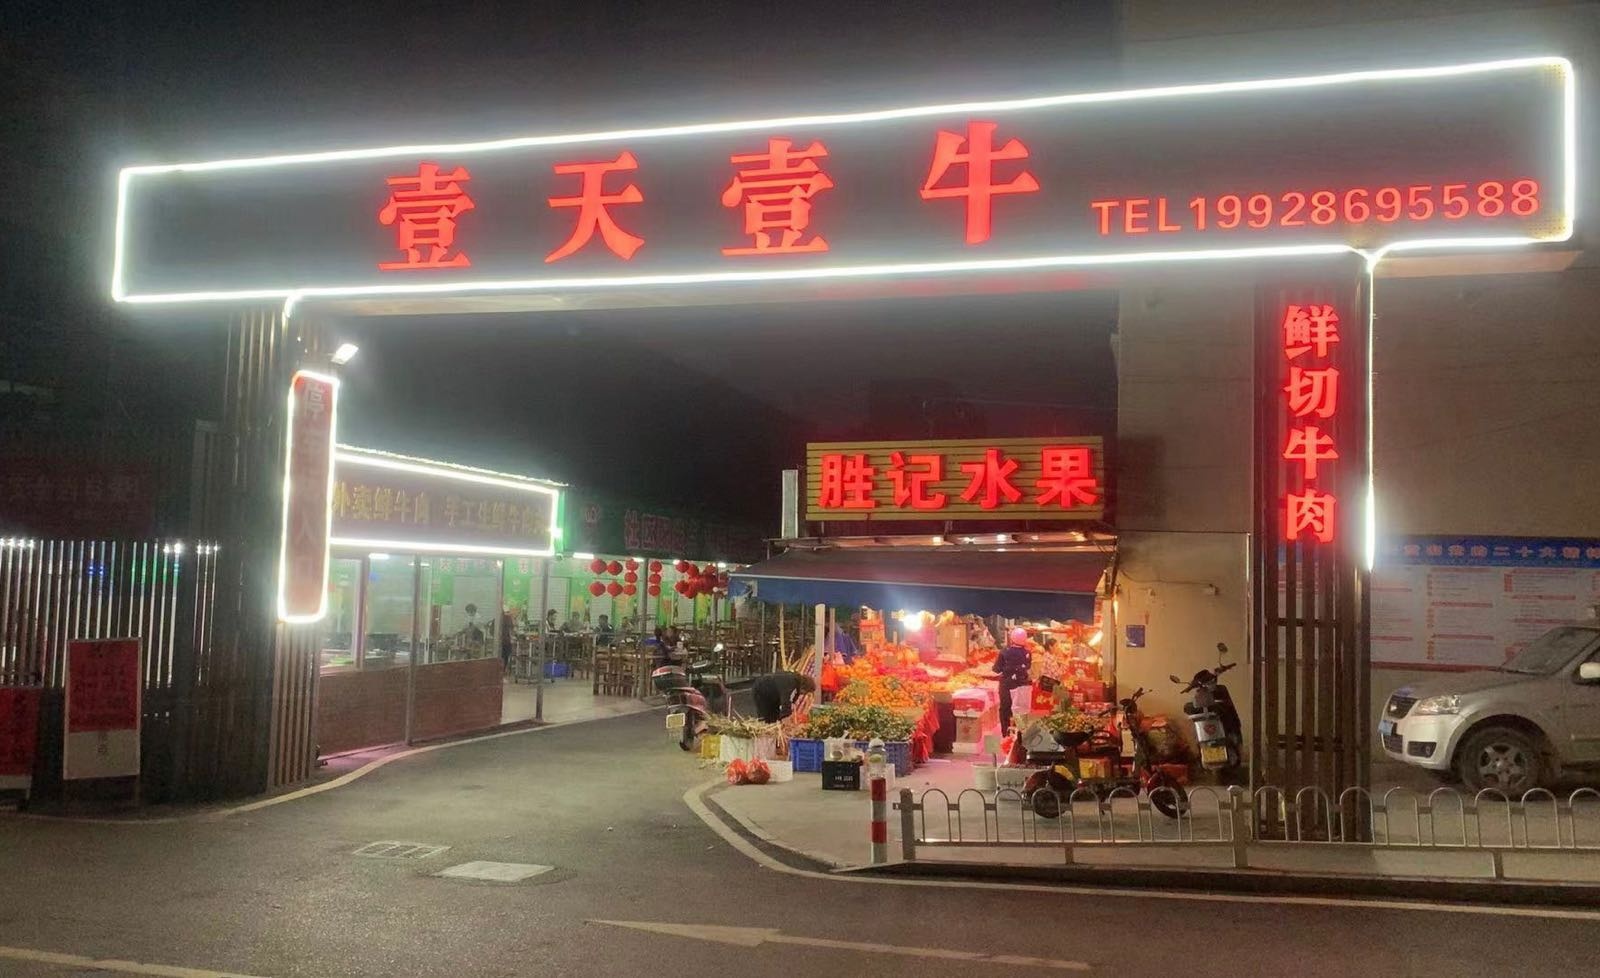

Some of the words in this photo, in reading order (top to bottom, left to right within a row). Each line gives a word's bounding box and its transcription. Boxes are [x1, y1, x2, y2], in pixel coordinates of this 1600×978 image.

[378, 121, 1040, 271] 壹天壹牛
[818, 447, 1098, 510] 胜记水果
[1281, 303, 1340, 544] 鲜切牛肉
